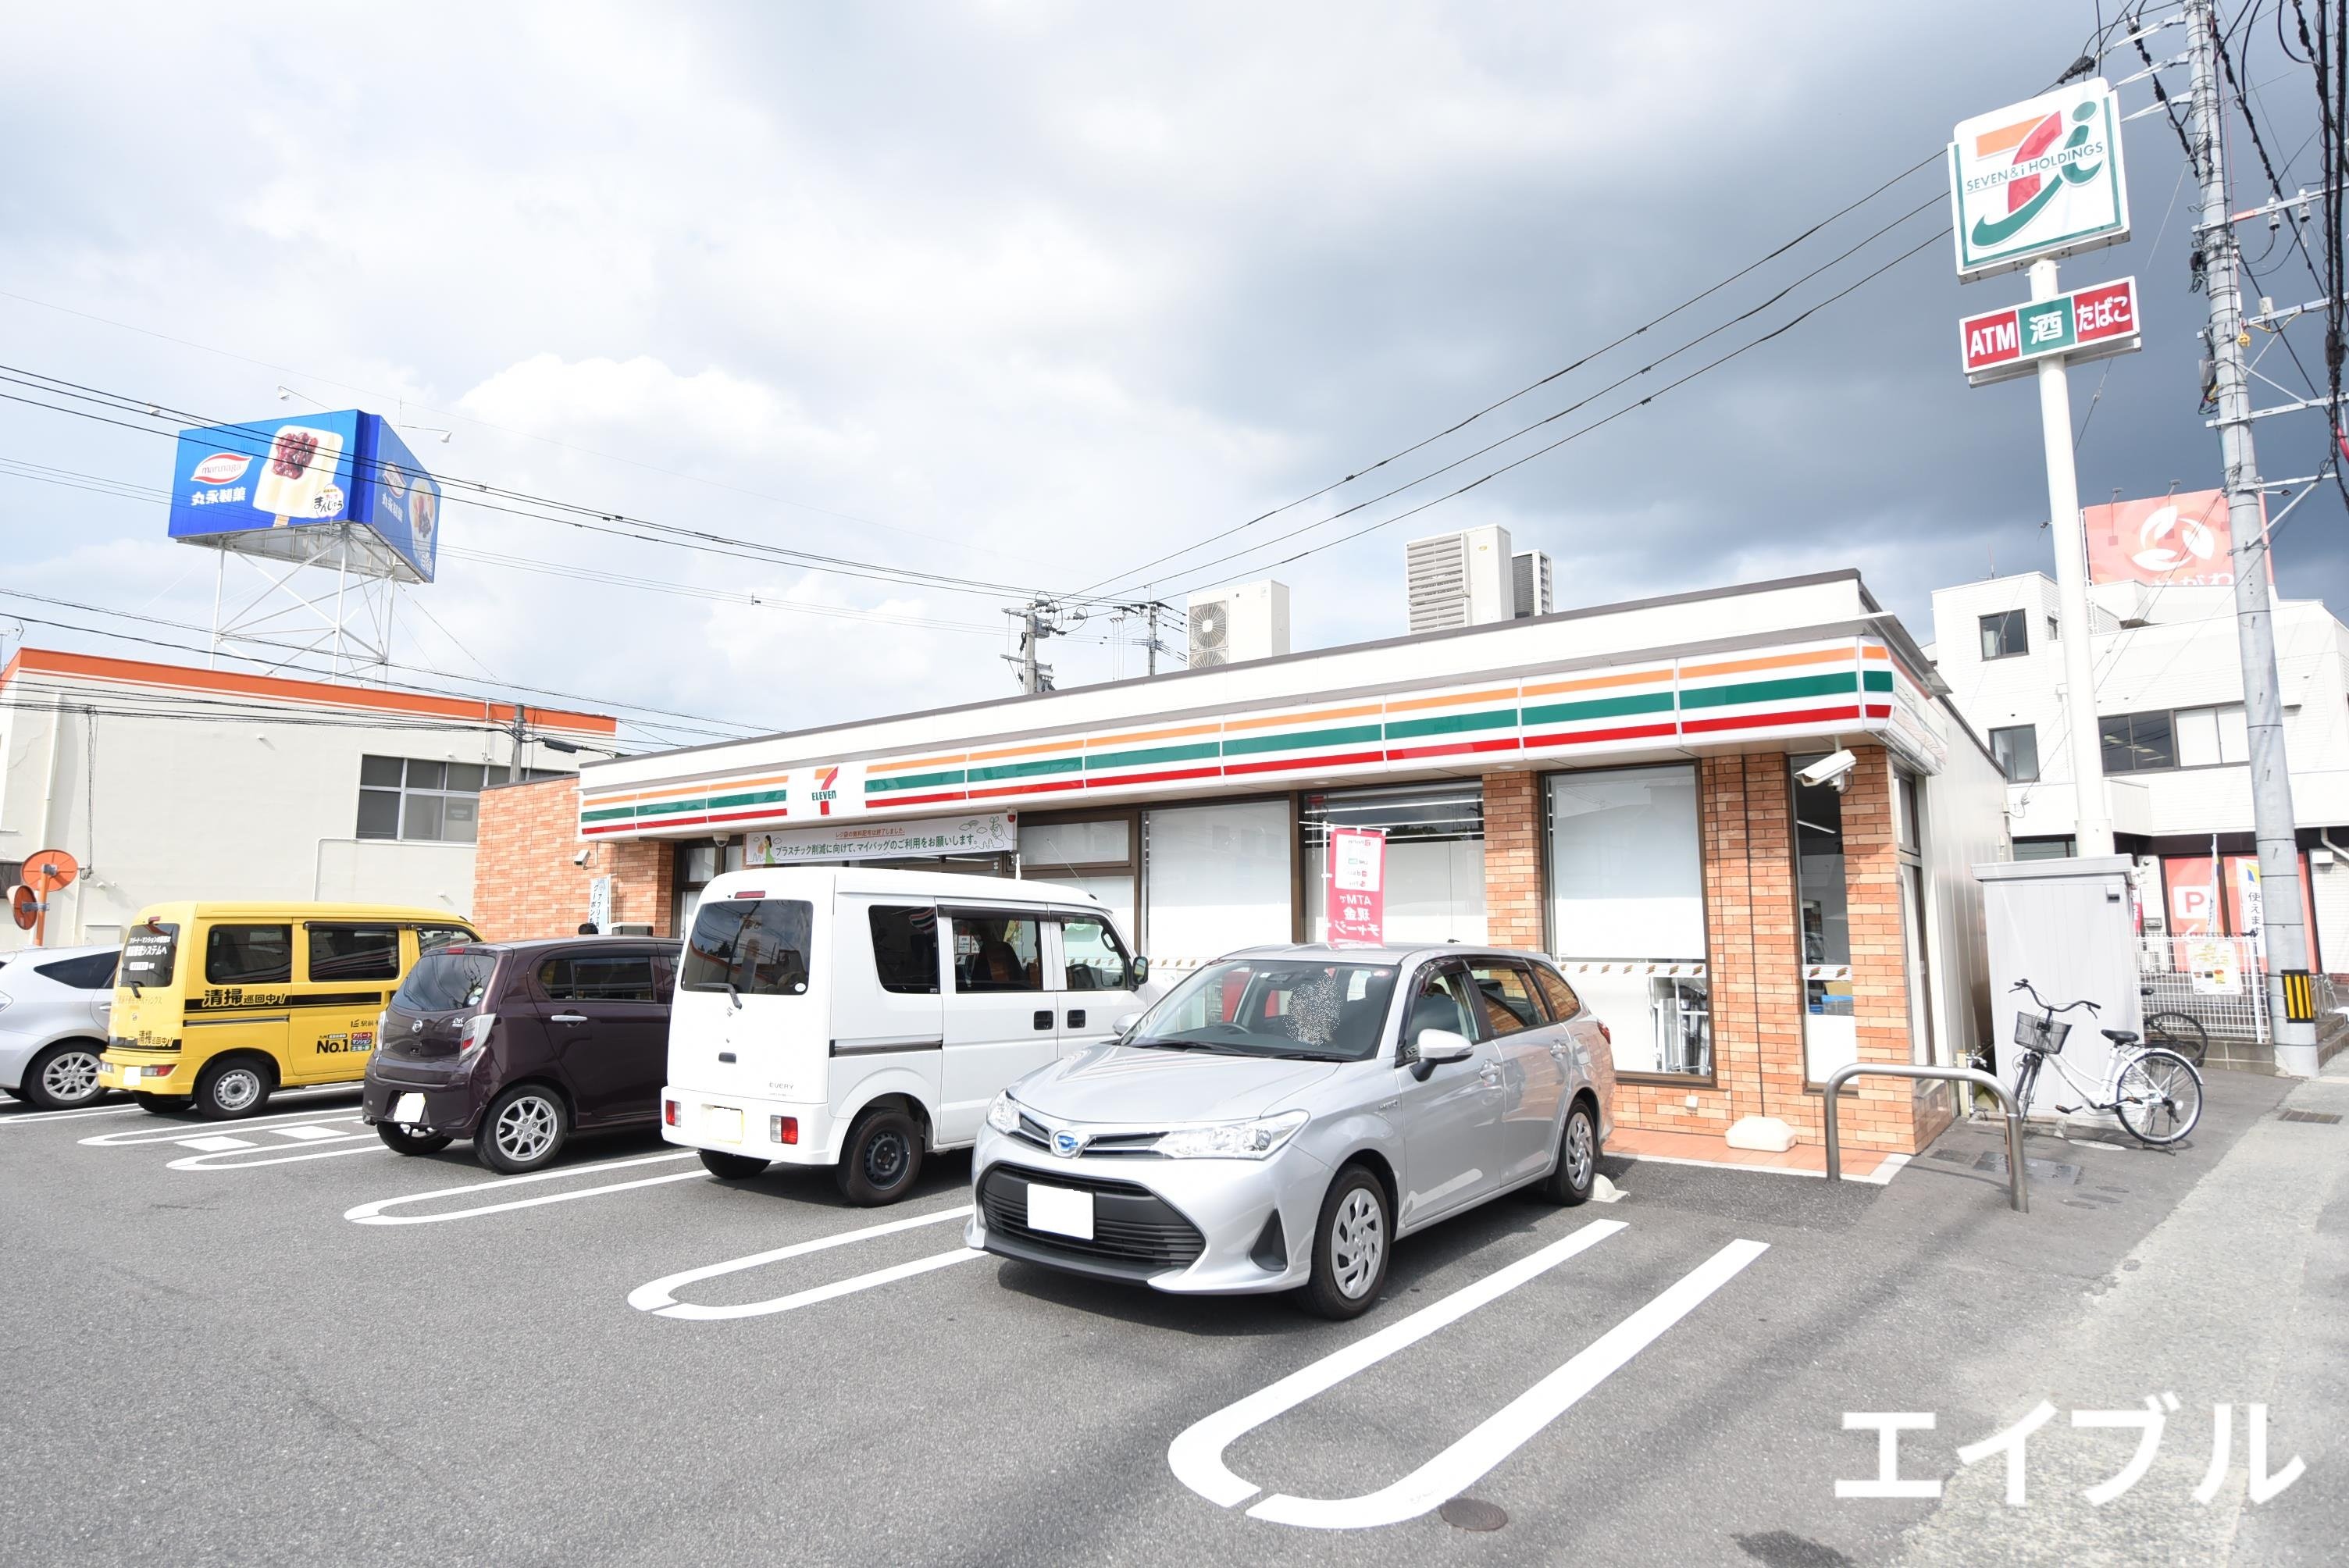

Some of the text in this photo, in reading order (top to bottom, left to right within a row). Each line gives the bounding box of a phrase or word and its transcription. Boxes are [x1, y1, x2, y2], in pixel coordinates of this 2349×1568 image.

[2029, 141, 2104, 173] HOLDINGS
[1969, 295, 2131, 358] ATM 酒 たばこ
[2185, 892, 2205, 913] P
[316, 1039, 348, 1053] No.1
